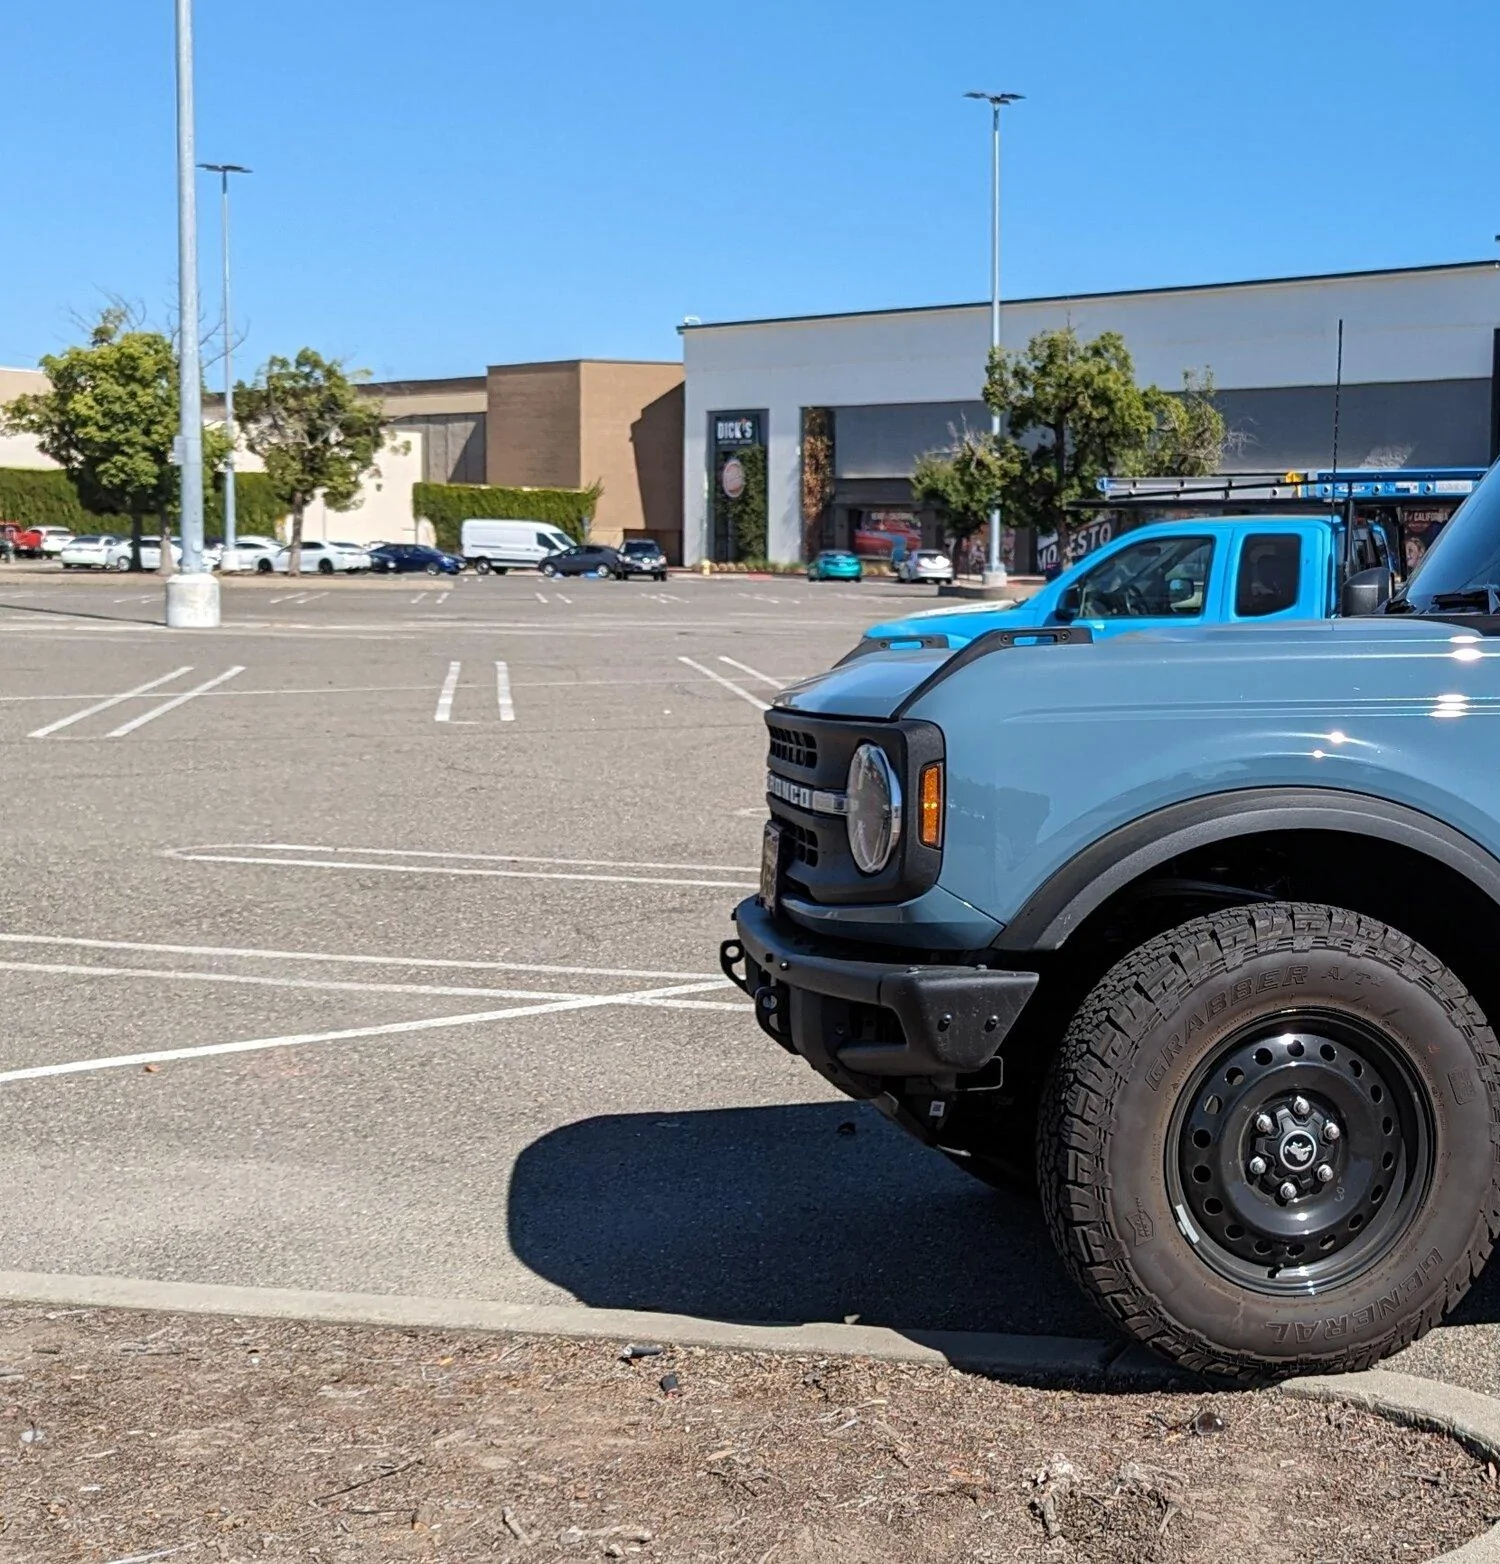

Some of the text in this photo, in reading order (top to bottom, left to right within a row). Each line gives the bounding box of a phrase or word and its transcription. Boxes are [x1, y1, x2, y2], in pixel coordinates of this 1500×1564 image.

[717, 420, 753, 439] DICK'S
[1145, 963, 1311, 1092] GRABBER
[1265, 1247, 1443, 1344] GENERAL
